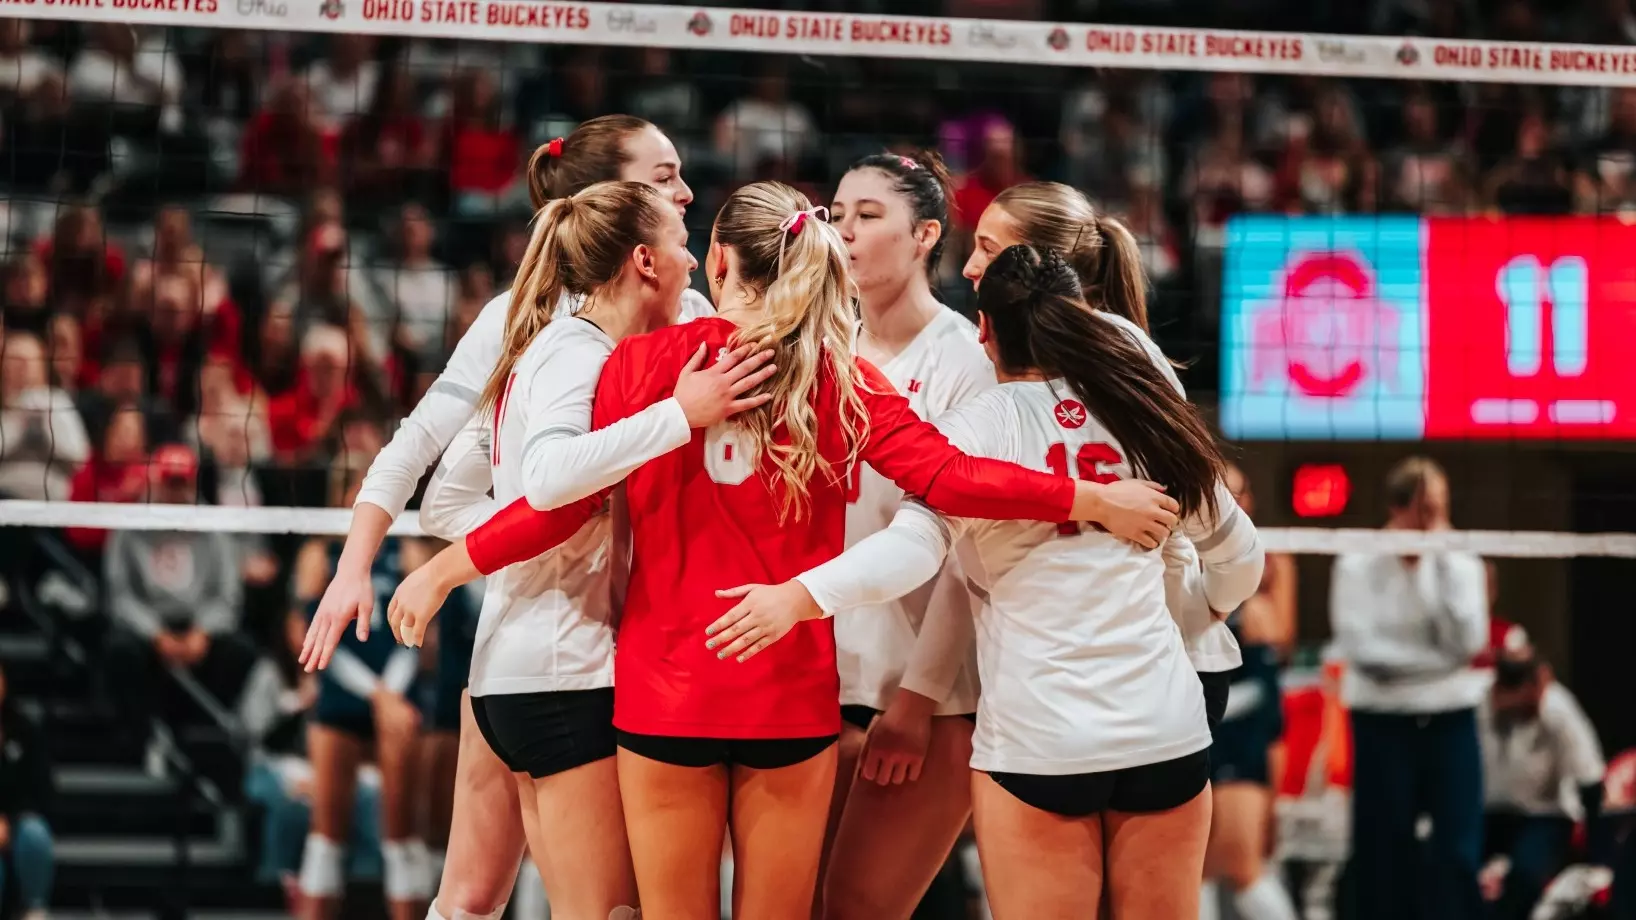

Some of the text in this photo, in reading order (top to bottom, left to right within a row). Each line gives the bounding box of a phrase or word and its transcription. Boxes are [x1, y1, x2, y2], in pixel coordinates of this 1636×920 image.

[362, 0, 590, 29] OHIO STATE BUCKEYES
[730, 14, 779, 38] OHIO
[786, 17, 842, 40] STATE
[851, 20, 951, 45] BUCKEYES
[1086, 30, 1135, 53] OHIO
[1142, 33, 1196, 56] STATE
[1204, 35, 1302, 60] BUCKEYES
[1434, 45, 1482, 67] OHIO
[1487, 48, 1542, 71] STATE
[1497, 256, 1587, 376] 11
